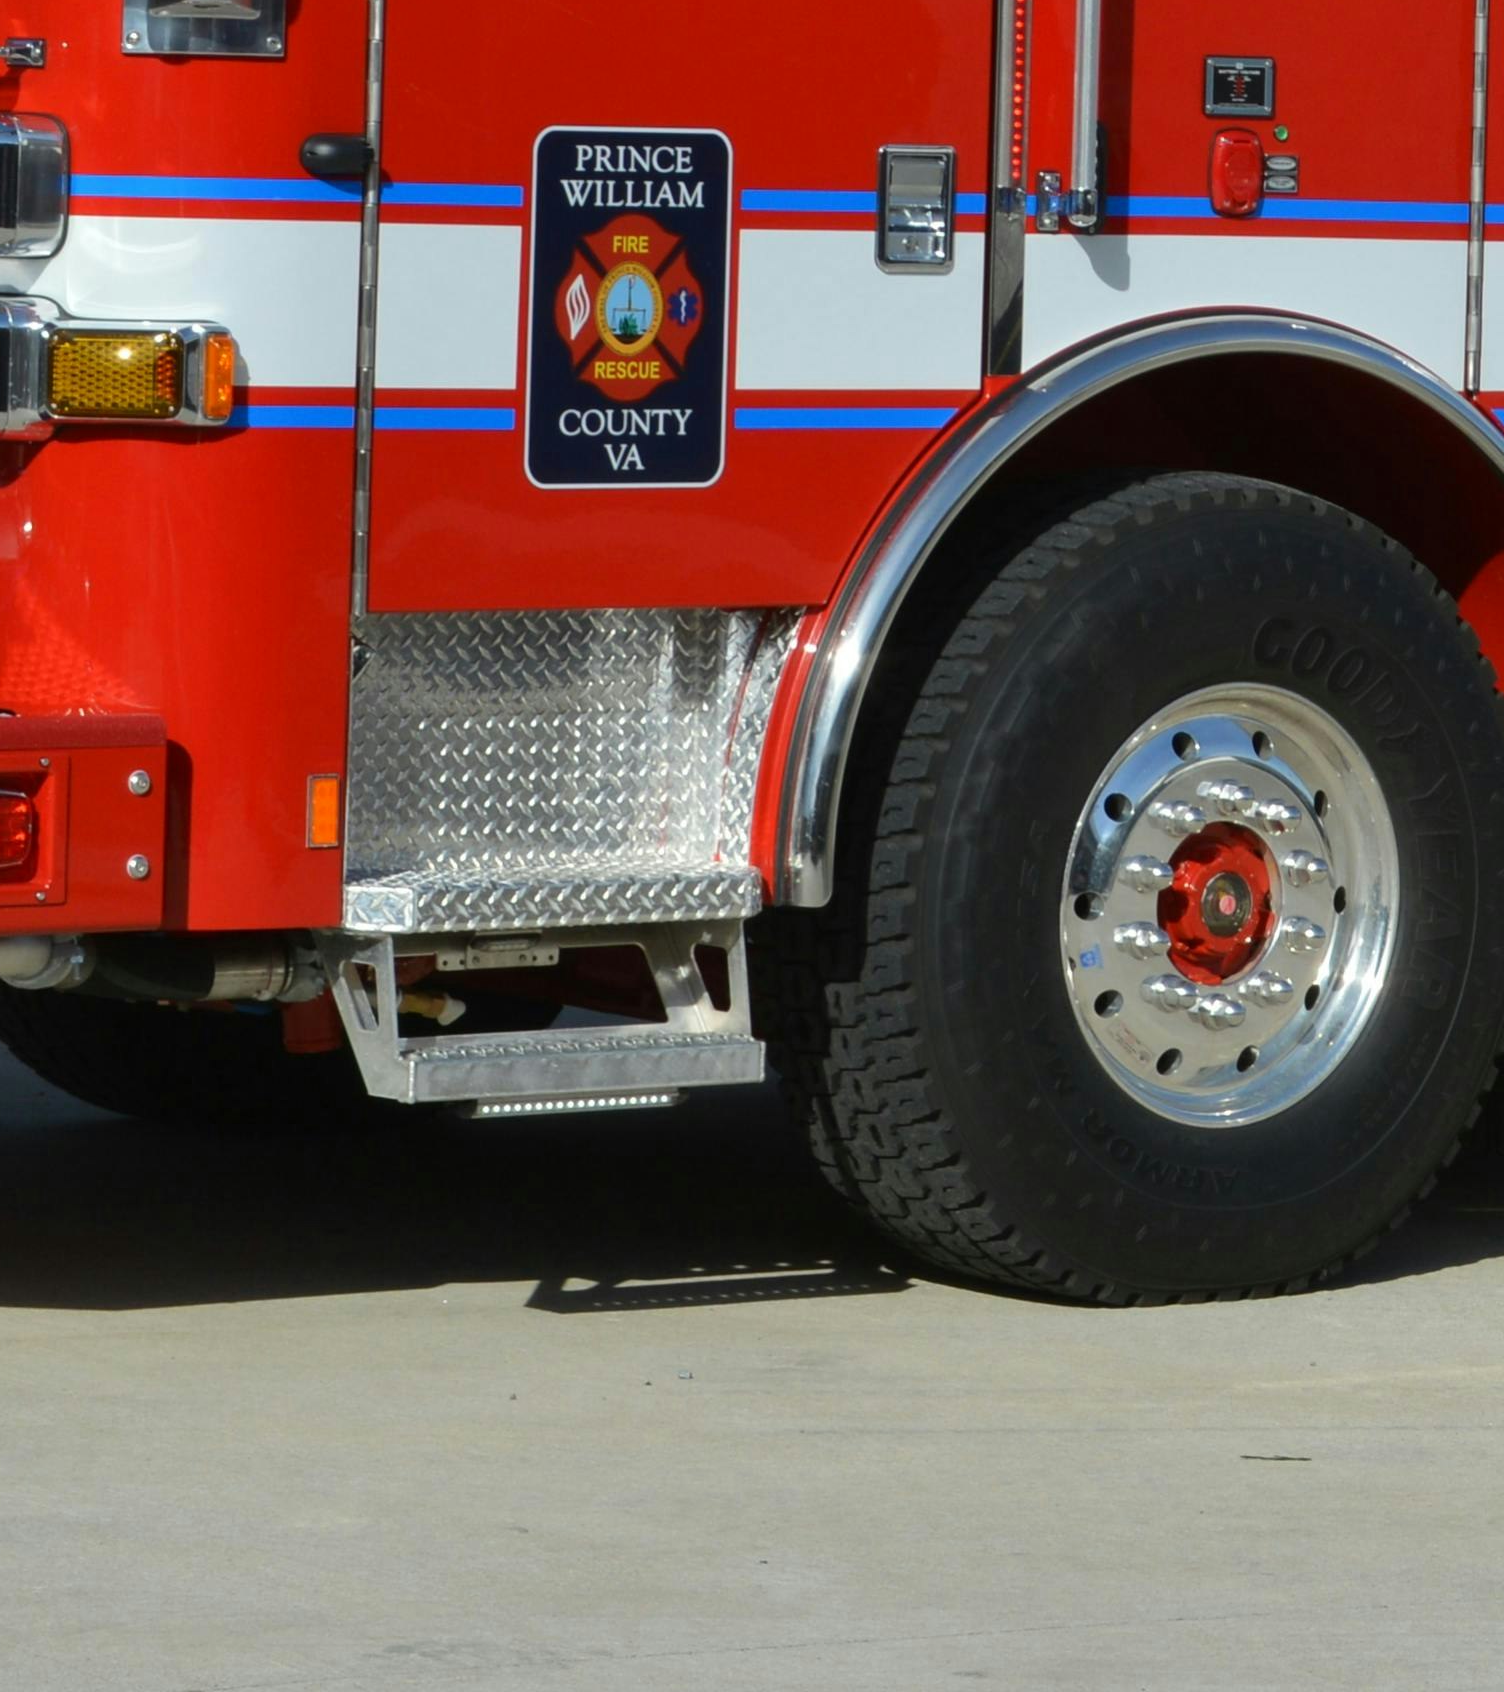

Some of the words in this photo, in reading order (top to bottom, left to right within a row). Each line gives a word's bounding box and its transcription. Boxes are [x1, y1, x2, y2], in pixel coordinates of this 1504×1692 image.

[575, 144, 694, 174] PRINCE
[560, 178, 705, 209] WILLIAM
[612, 235, 650, 254] FIRE
[594, 361, 661, 380] RESCUE
[558, 407, 694, 437] COUNTY
[604, 443, 646, 471] VA
